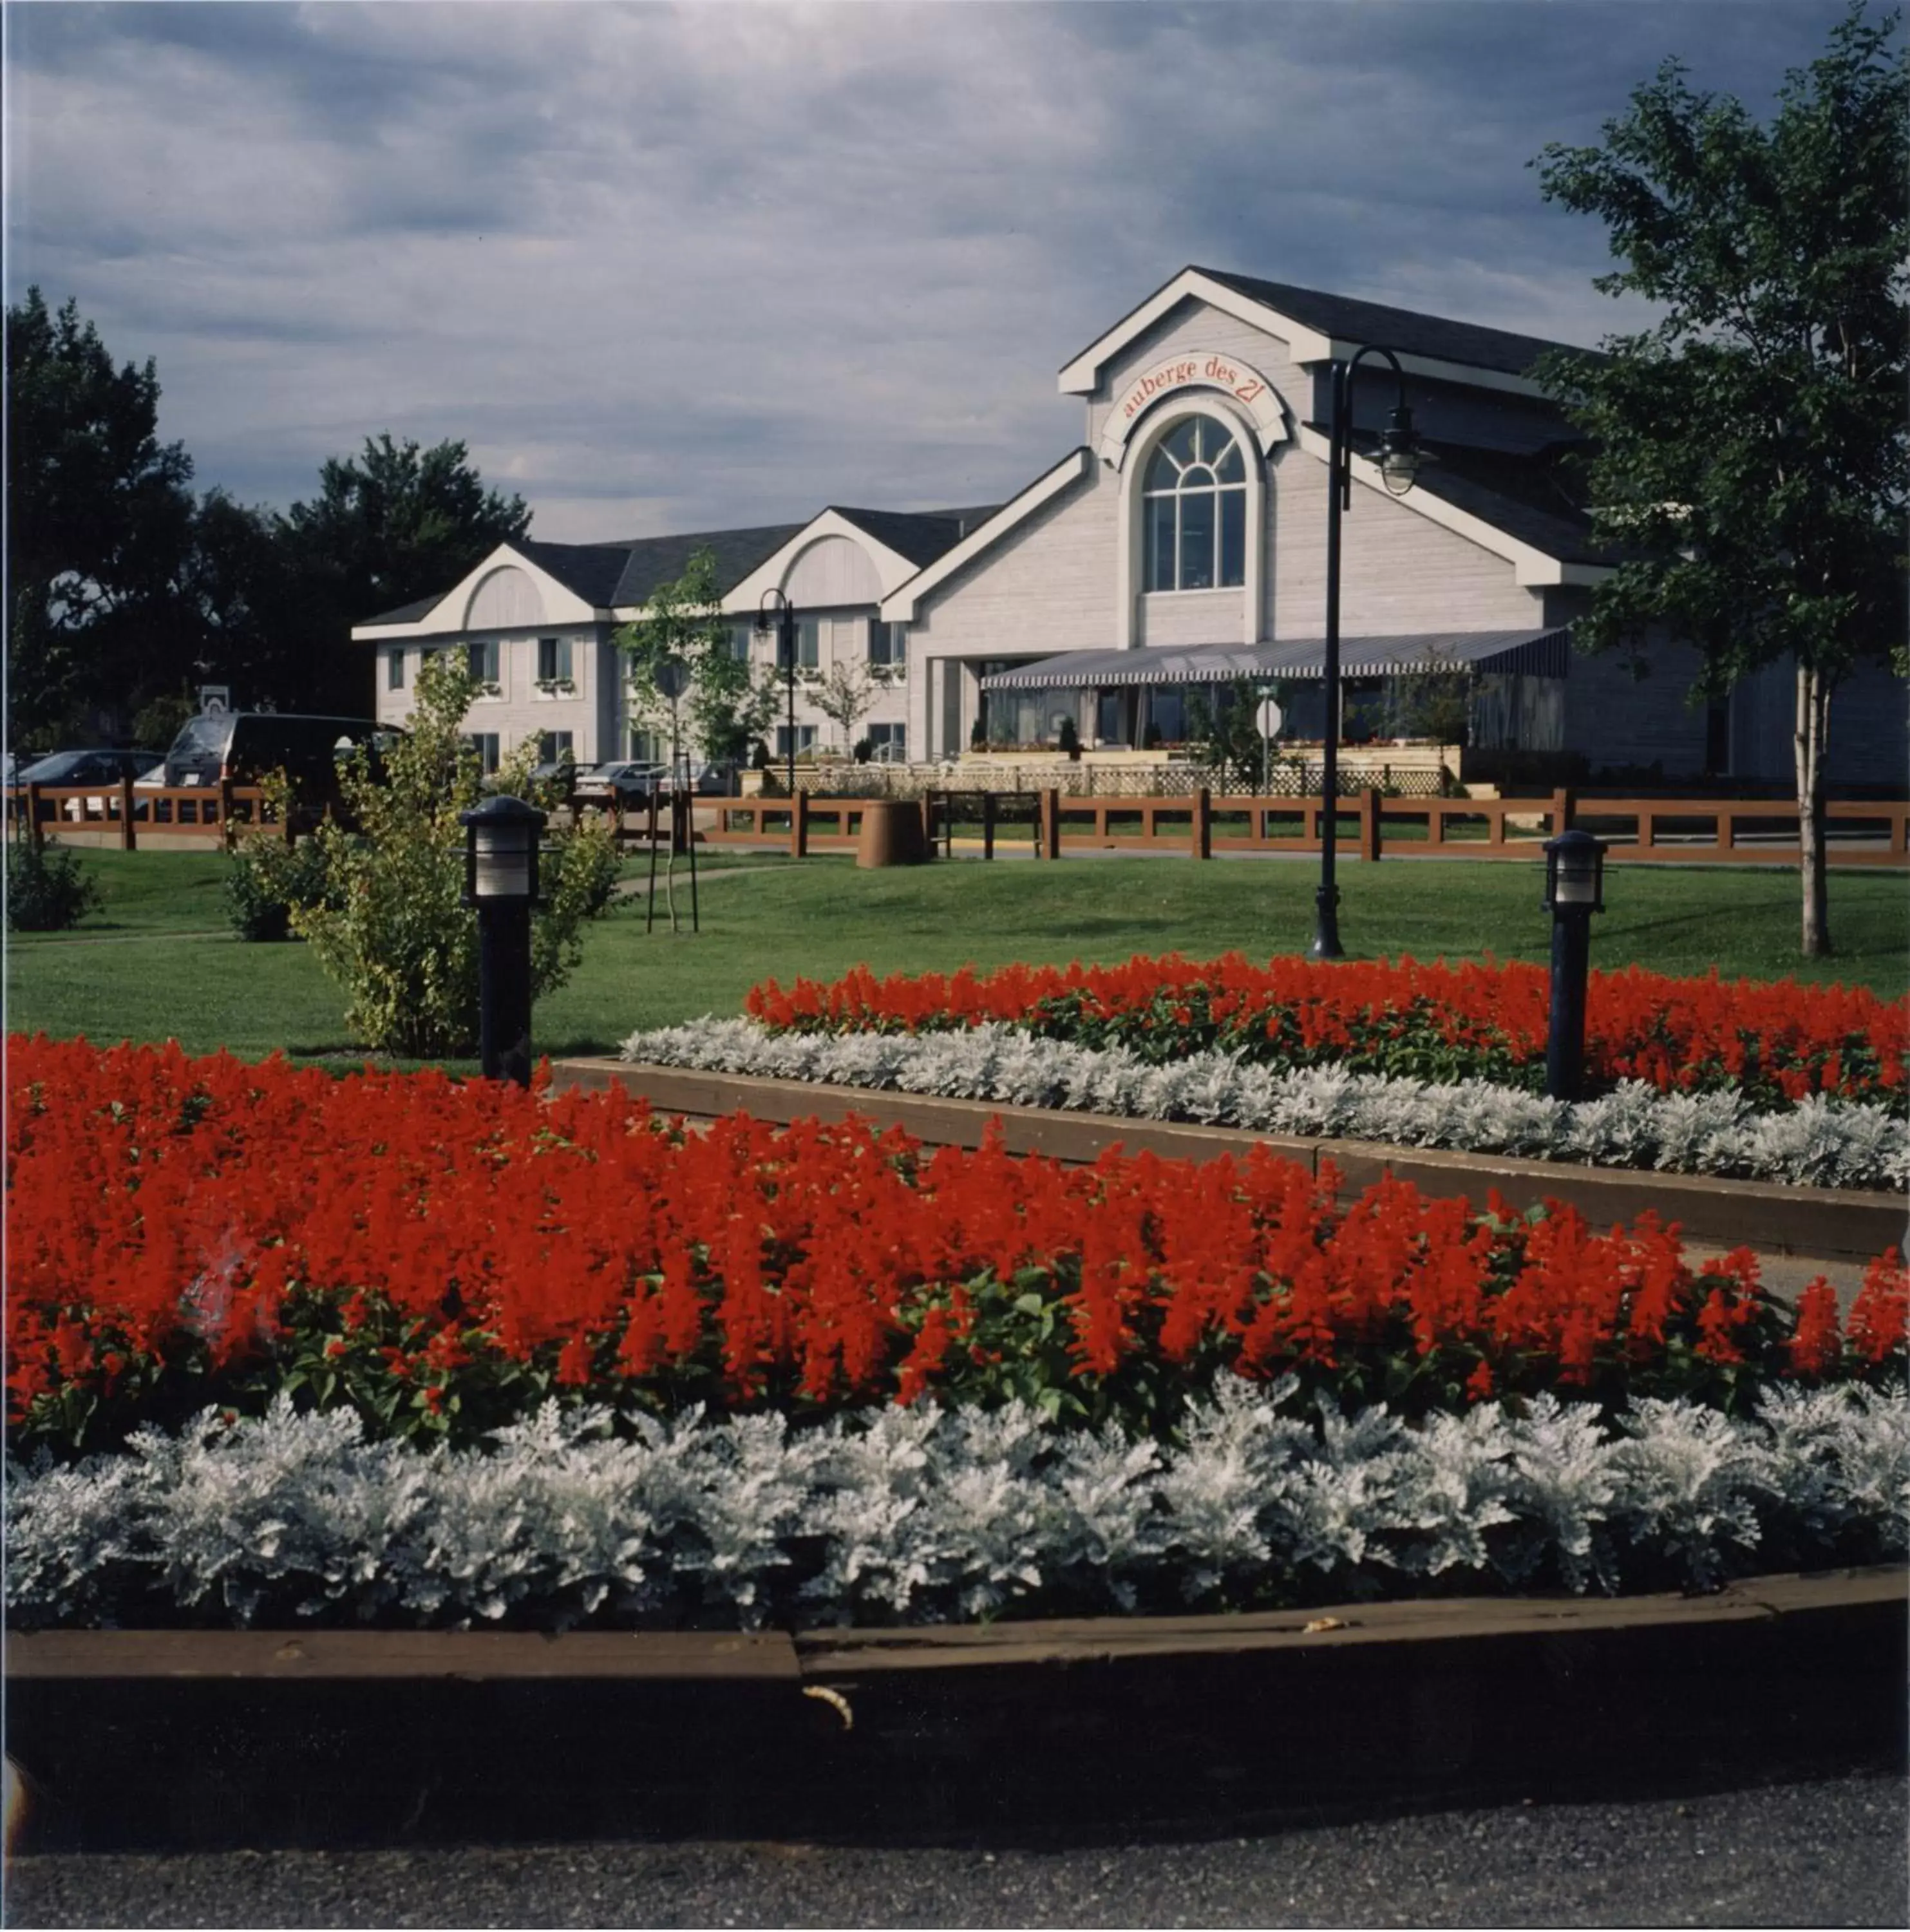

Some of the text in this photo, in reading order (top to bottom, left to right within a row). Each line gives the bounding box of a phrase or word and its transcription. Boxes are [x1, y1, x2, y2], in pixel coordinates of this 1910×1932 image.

[1124, 357, 1265, 417] auberge des 21
